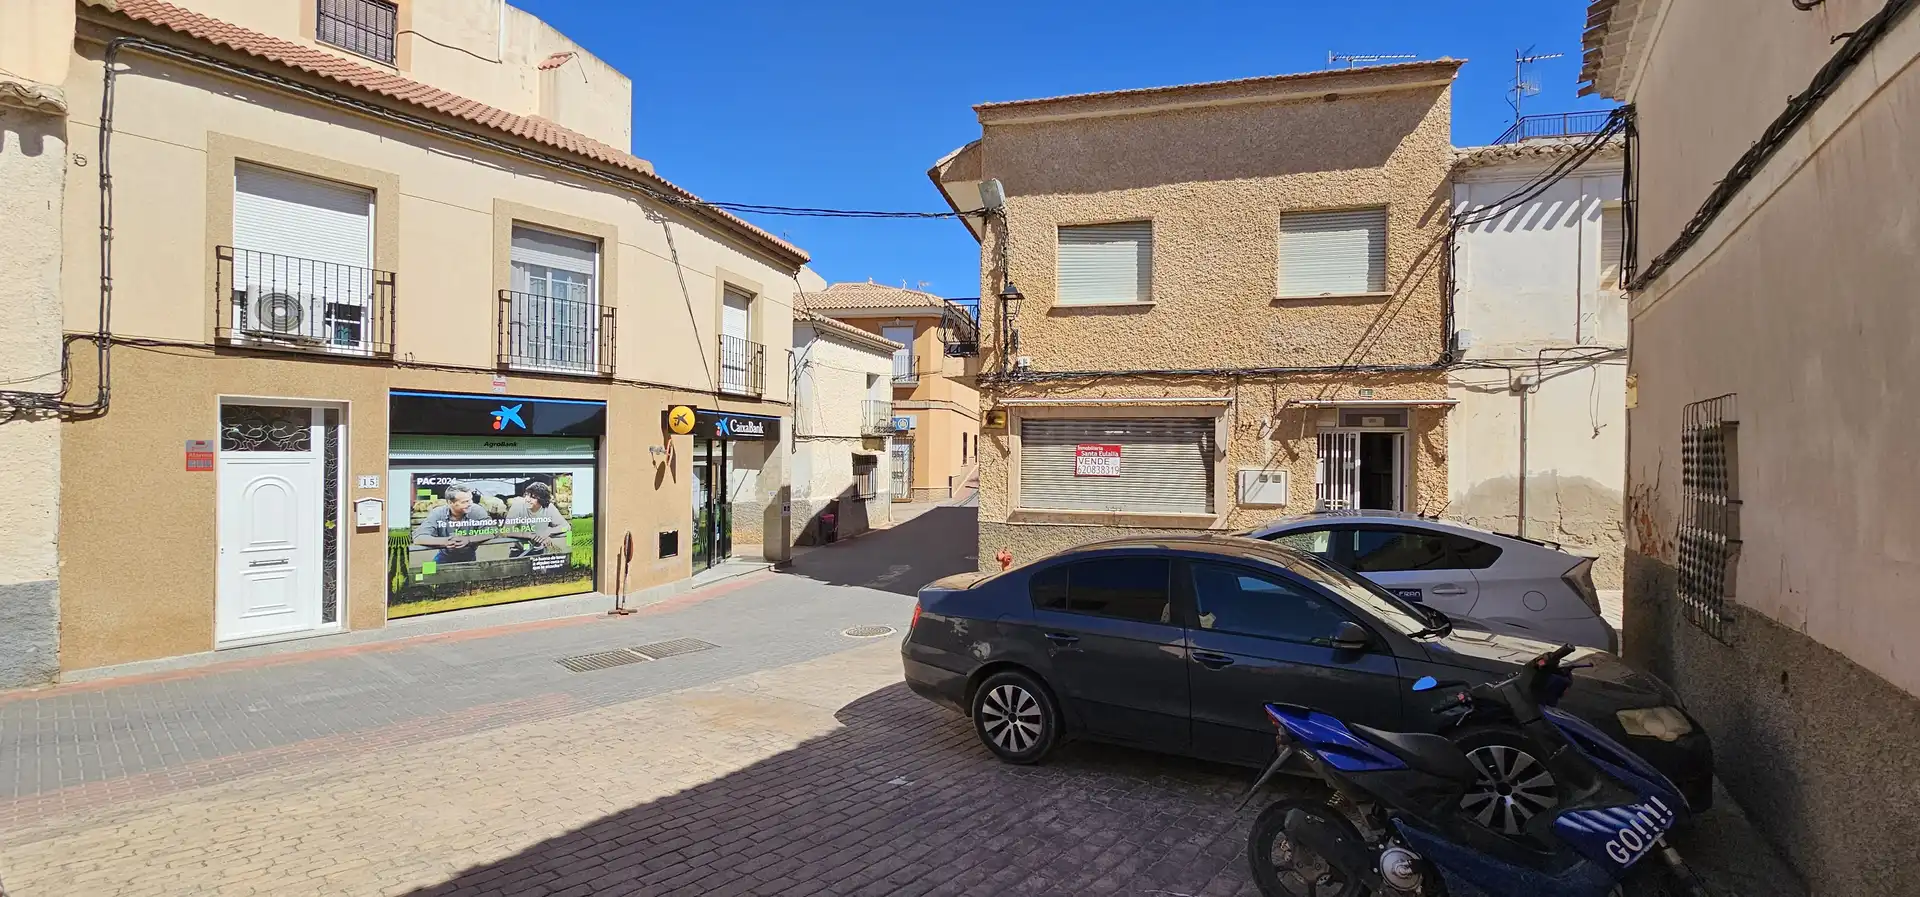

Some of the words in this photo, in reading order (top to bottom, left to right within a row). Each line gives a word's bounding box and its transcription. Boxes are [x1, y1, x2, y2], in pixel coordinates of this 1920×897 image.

[730, 419, 764, 434] CaixaBank
[1078, 457, 1110, 466] VENDE
[1077, 465, 1120, 475] 620838319
[416, 477, 436, 486] PAC
[436, 477, 457, 485] 2024
[436, 520, 447, 528] Te
[449, 518, 497, 528] tramitamos
[498, 519, 505, 527] y
[505, 516, 552, 525] anticipamos
[455, 528, 467, 536] las
[469, 527, 498, 536] ayudas
[500, 526, 511, 534] de
[520, 525, 537, 533] PAC
[1605, 795, 1673, 864] GO!!!!
